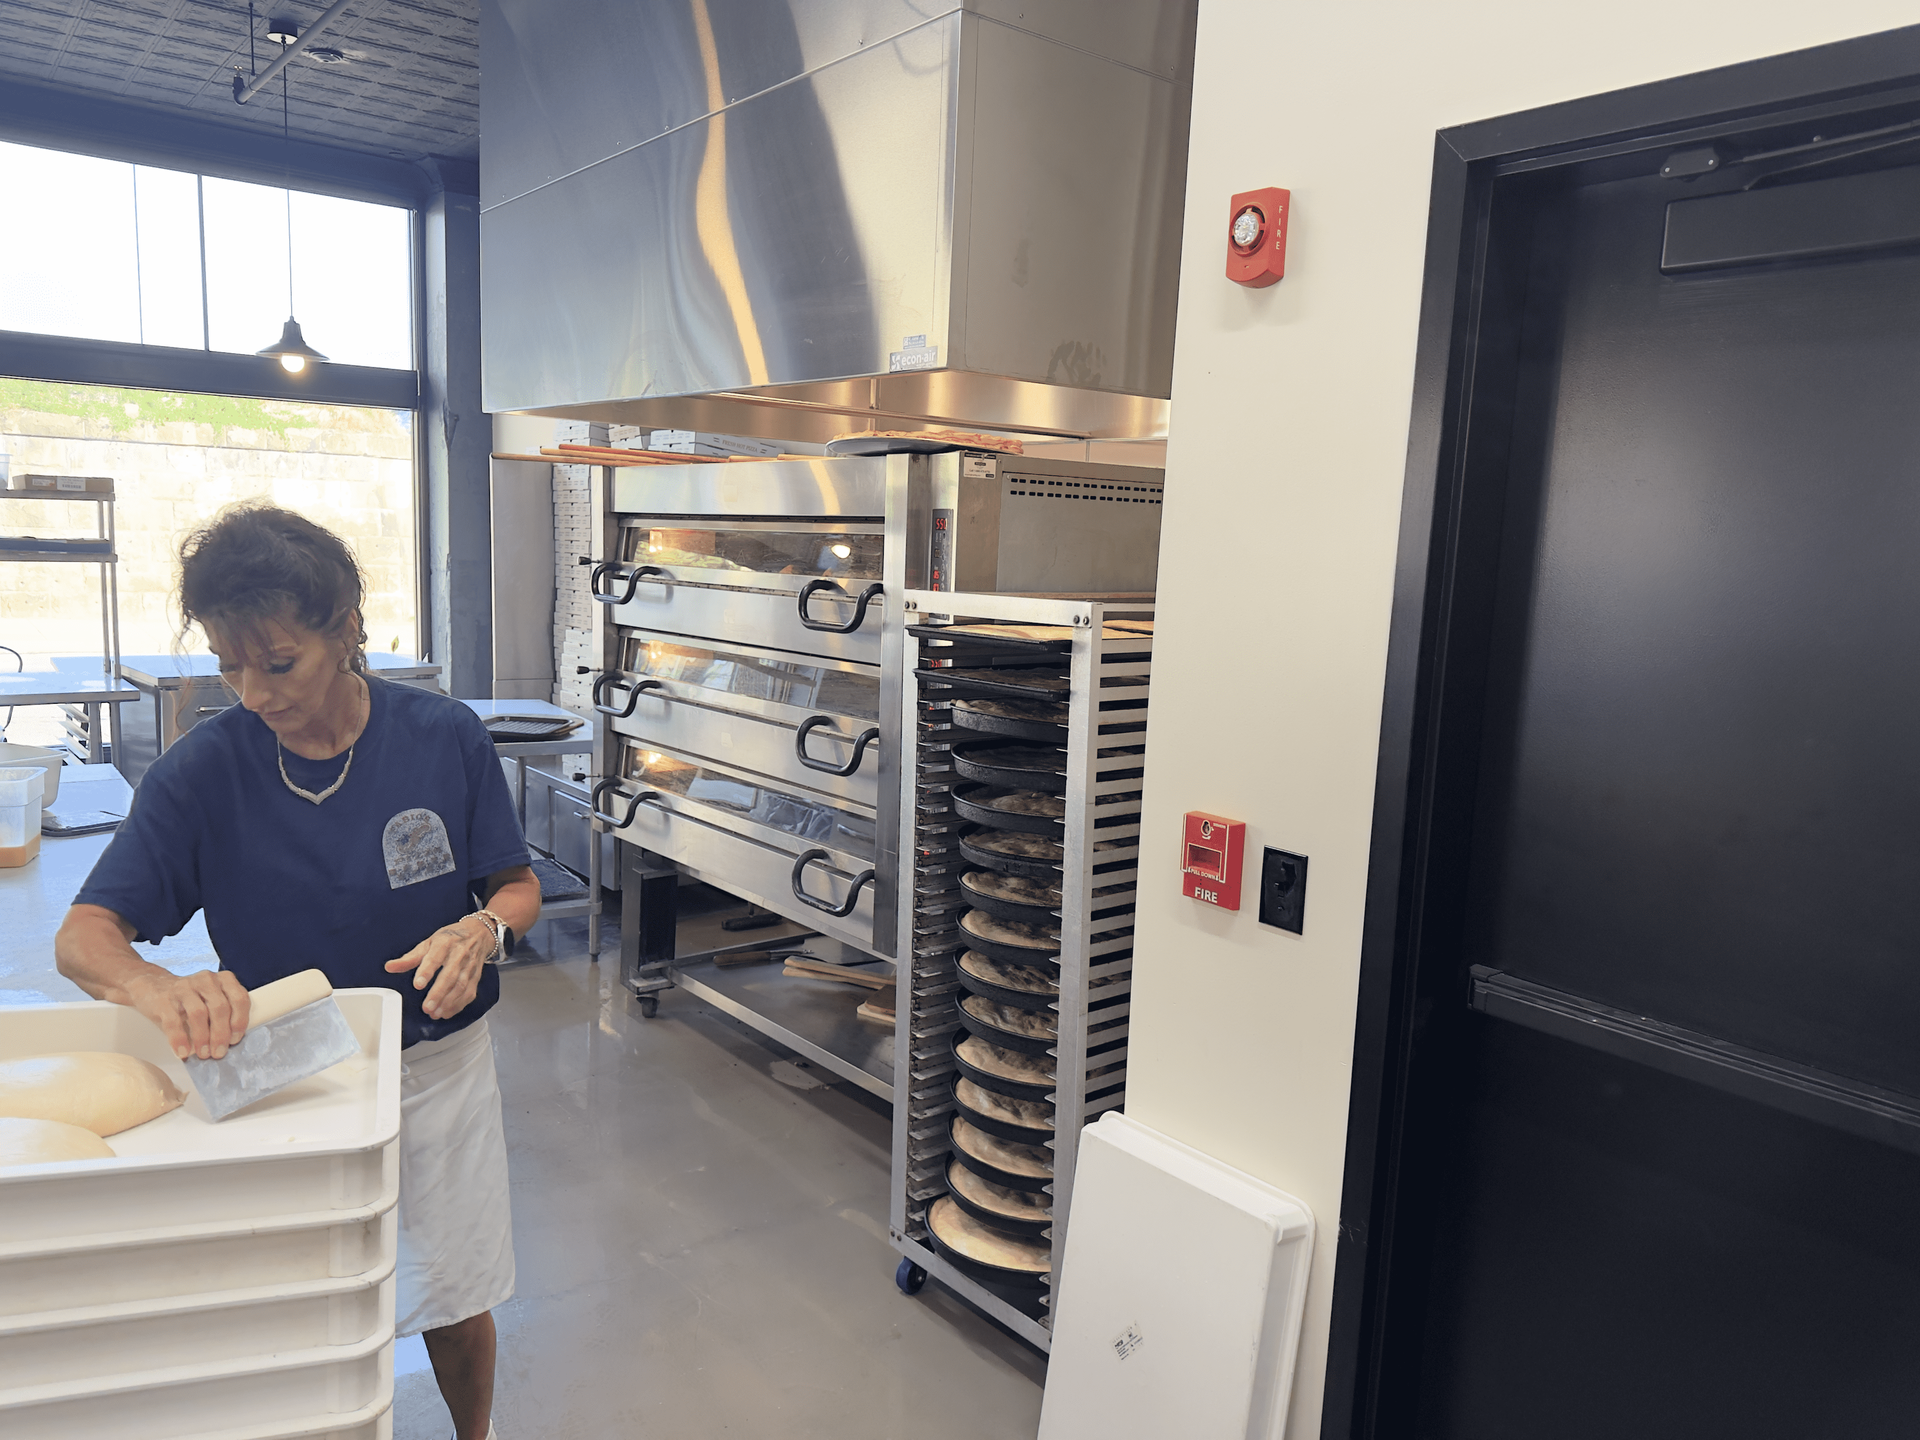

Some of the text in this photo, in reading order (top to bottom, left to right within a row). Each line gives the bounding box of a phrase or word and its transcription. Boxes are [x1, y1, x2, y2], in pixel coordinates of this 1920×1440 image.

[745, 444, 758, 453] PIZZA
[1201, 871, 1216, 880] DOWN
[1194, 886, 1218, 903] FIRE
